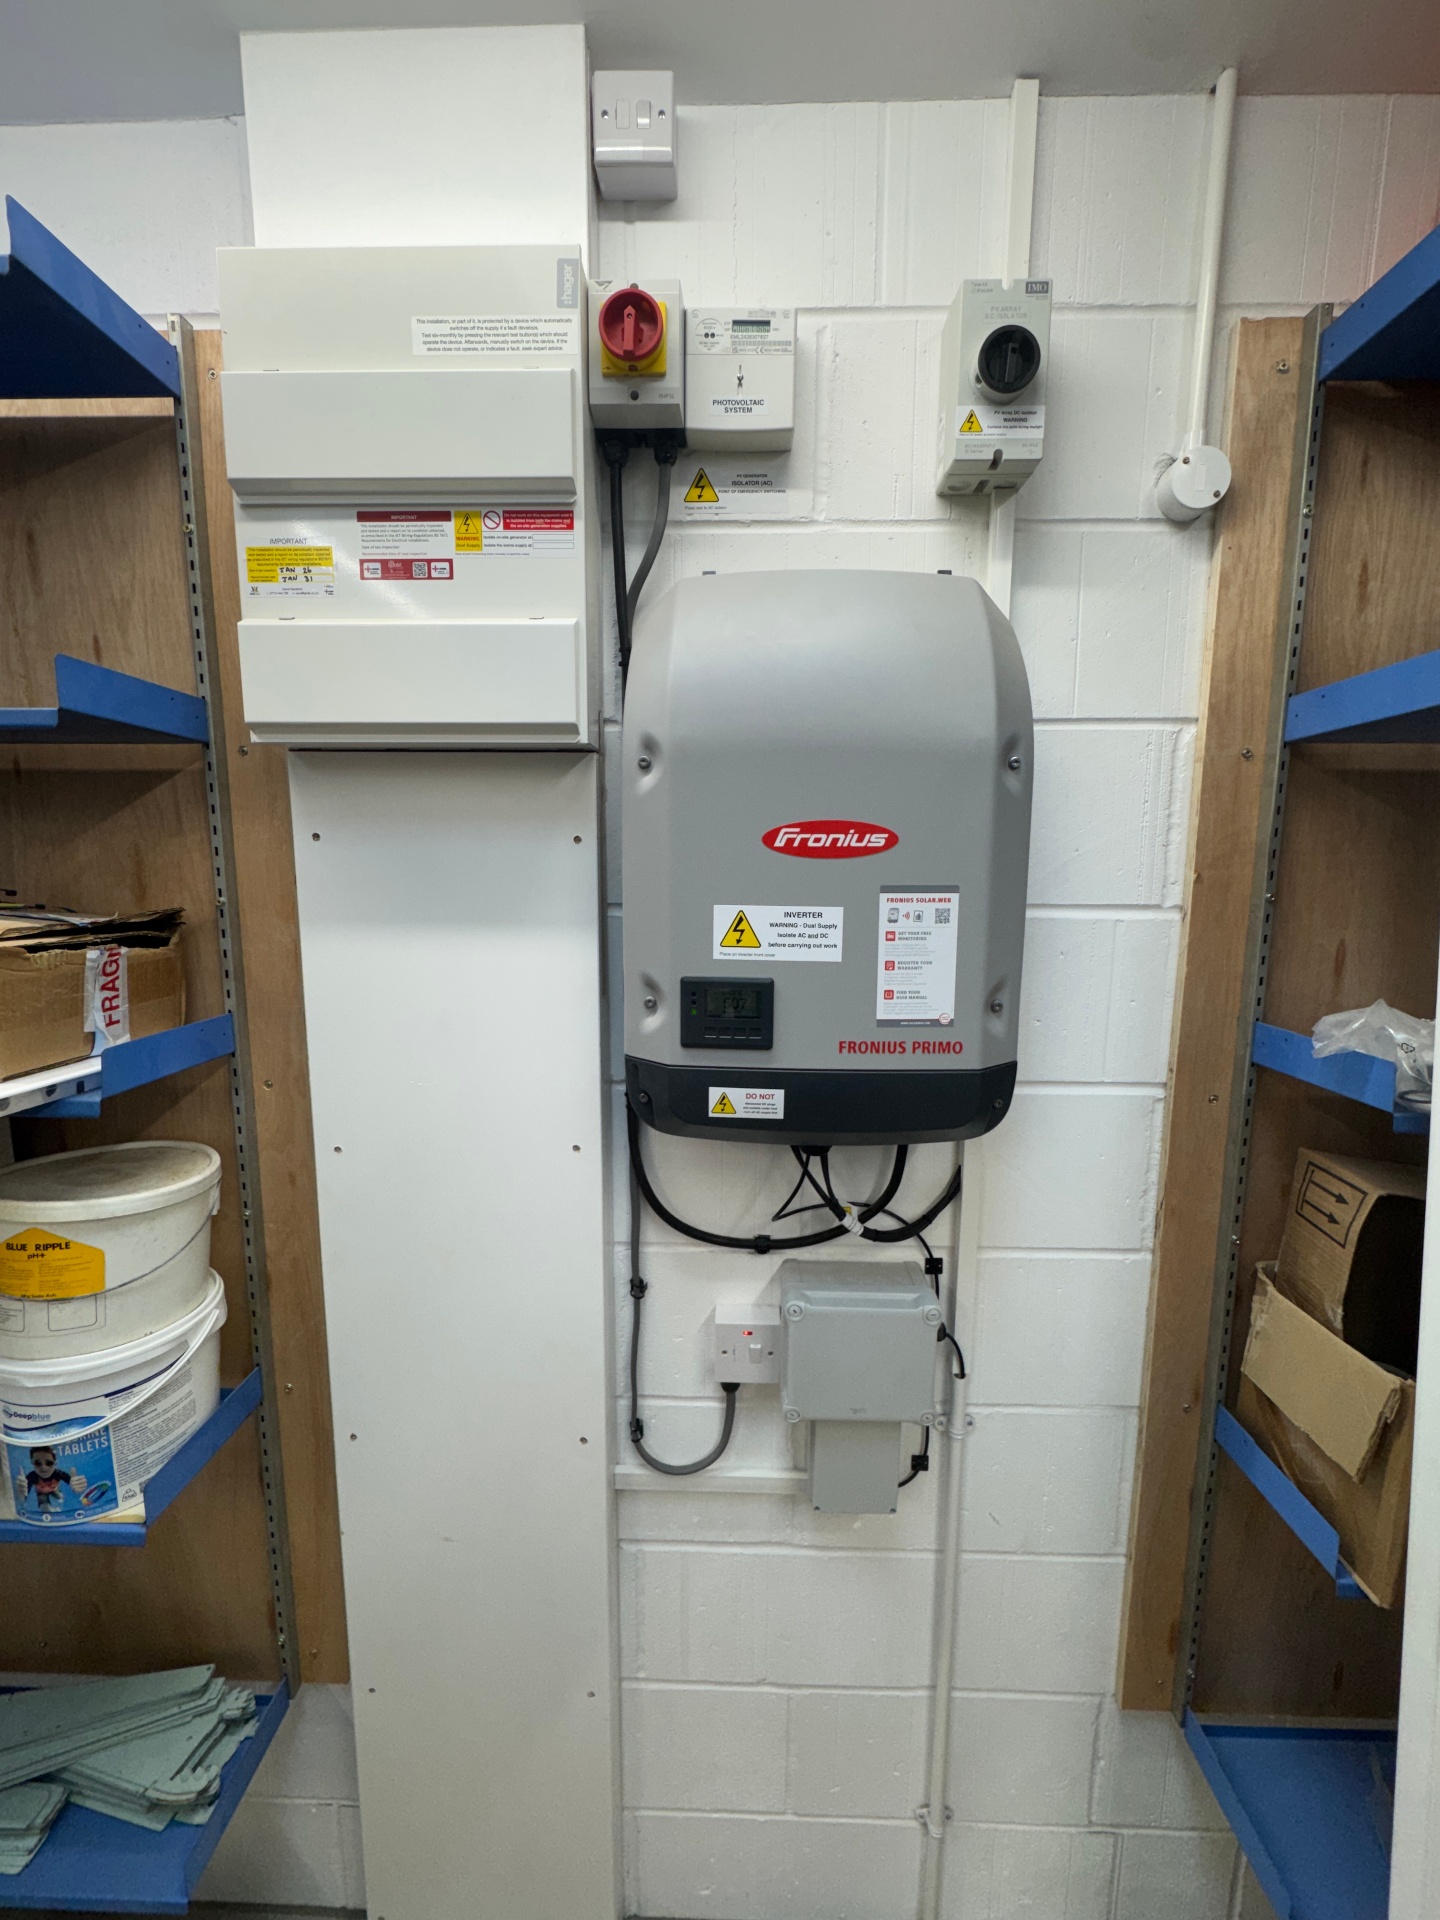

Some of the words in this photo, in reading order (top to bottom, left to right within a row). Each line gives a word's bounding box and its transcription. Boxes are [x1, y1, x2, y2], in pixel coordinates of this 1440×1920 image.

[561, 264, 574, 300] hager
[1028, 283, 1047, 292] IMO
[774, 828, 889, 847] Fronius
[838, 1041, 907, 1054] FRONIUS
[912, 1041, 963, 1054] PRIMO
[6, 1243, 28, 1251] BLUE
[35, 1242, 71, 1251] RIPPLE
[57, 1436, 108, 1456] TABLETS
